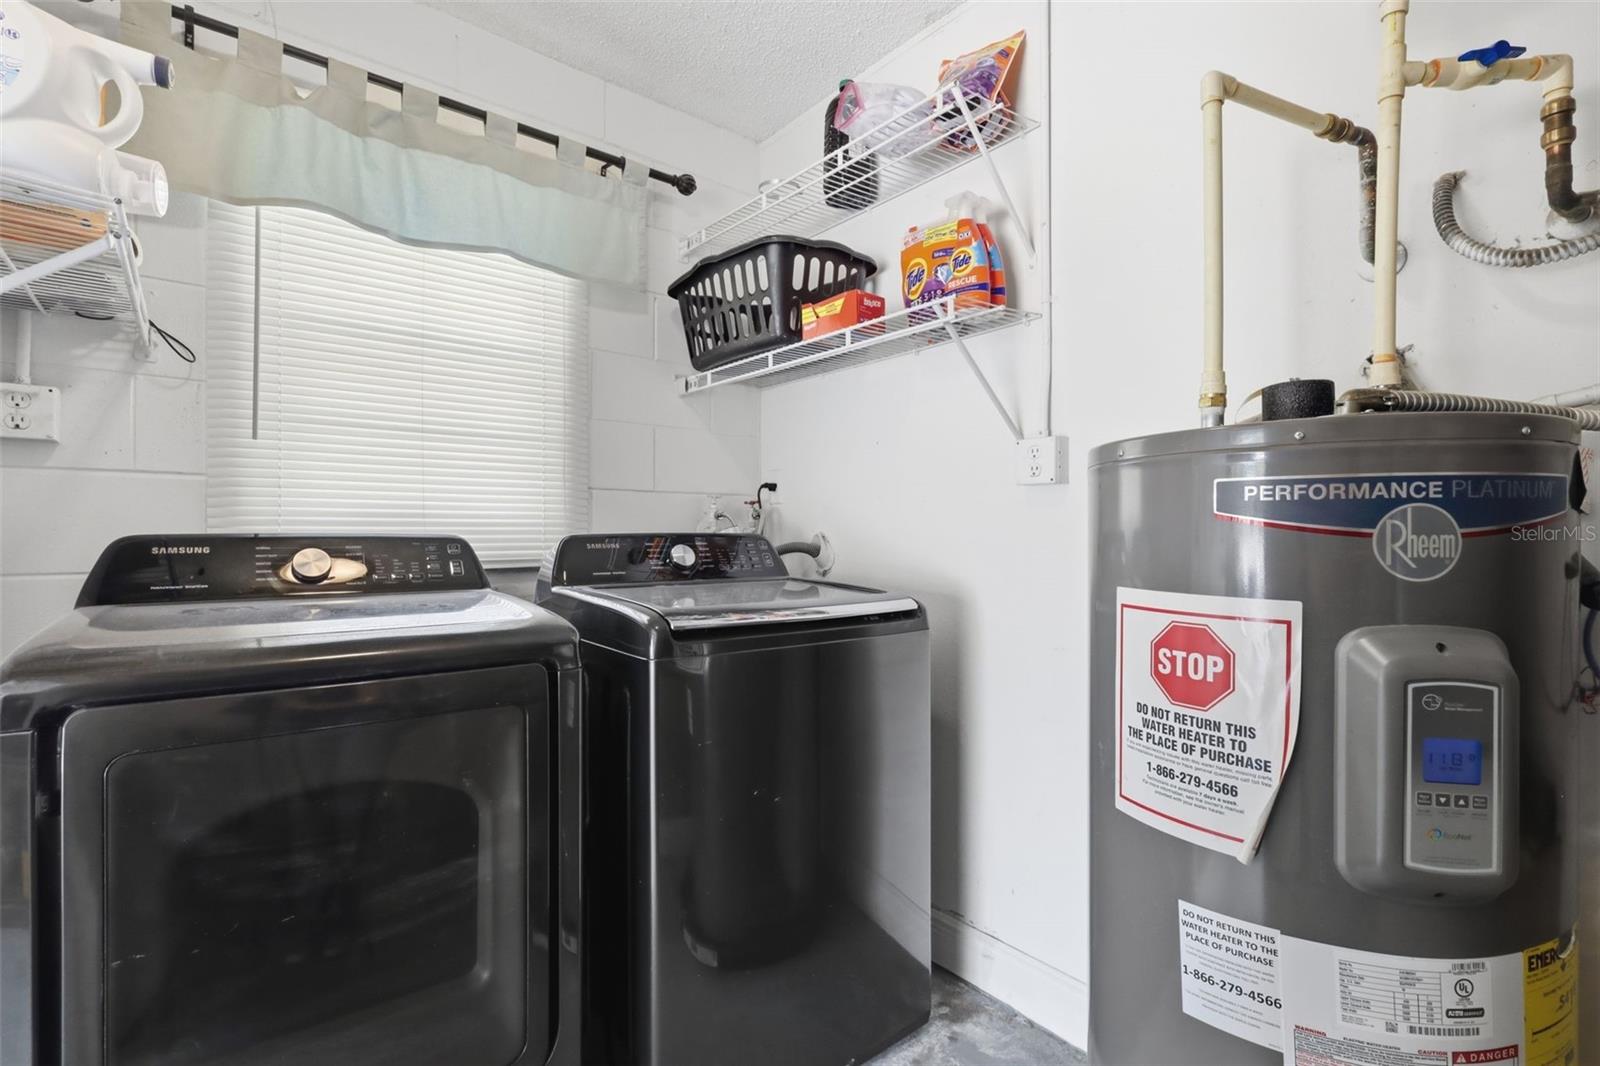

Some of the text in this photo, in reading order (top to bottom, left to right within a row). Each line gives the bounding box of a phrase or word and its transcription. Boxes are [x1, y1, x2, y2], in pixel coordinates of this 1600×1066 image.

[906, 266, 925, 292] Tide
[952, 253, 972, 272] Tide
[947, 274, 977, 288] RESCUE
[1244, 479, 1553, 501] PERFORMANCE PLATINUM
[151, 546, 210, 554] SAMSUNG
[1386, 507, 1456, 569] Rheem
[1157, 647, 1224, 682] STOP
[1136, 702, 1256, 739] DO NOT RETURN THIS
[1141, 717, 1247, 752] WATER HEATER TO
[1128, 725, 1272, 773] THE PLACE OF PURCHASE
[1147, 761, 1239, 797] 1-866-279-4566
[1181, 919, 1279, 957] WATER HEATER TO THE
[1183, 909, 1276, 944] DO NOT RETURN THIS
[1185, 931, 1274, 967] PLACE OF PURCHASE
[1183, 964, 1282, 1010] 1-866-279-4566
[1294, 1024, 1327, 1037] WARNING
[1470, 1047, 1515, 1063] DANGER
